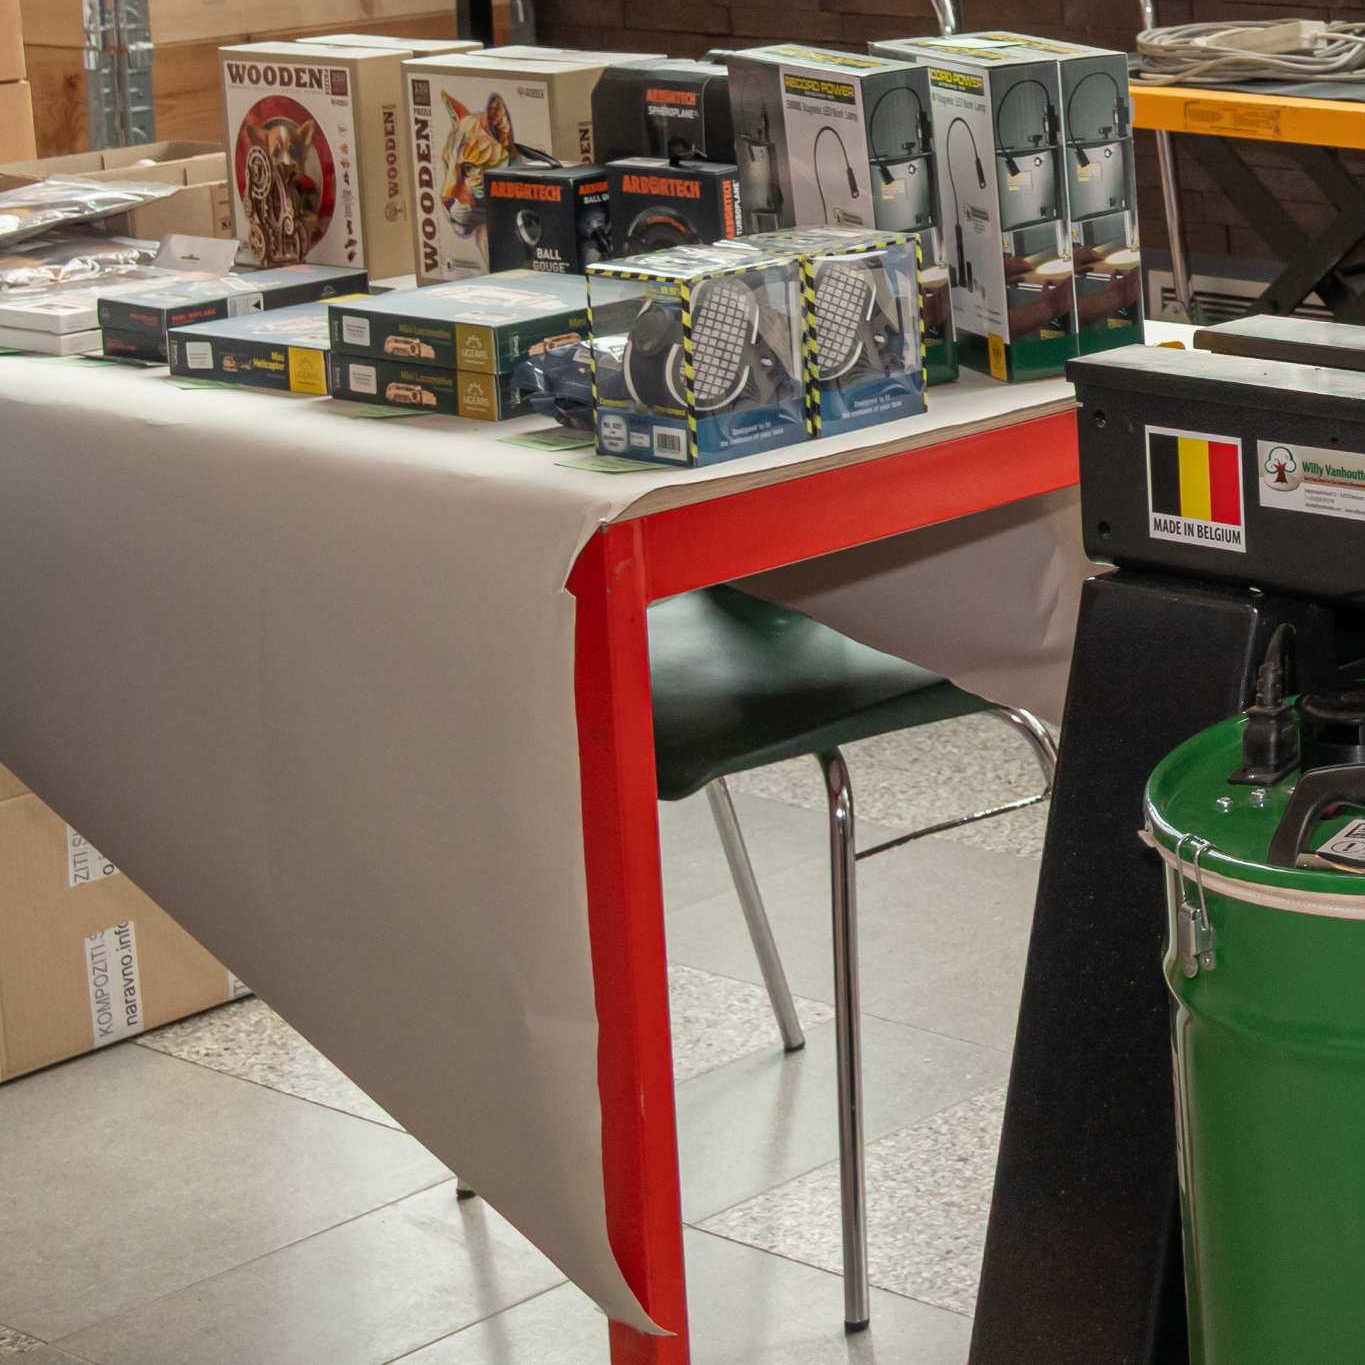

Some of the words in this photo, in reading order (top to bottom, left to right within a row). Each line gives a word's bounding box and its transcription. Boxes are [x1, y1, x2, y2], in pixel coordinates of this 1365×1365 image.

[226, 63, 323, 90] WOODEN
[783, 74, 820, 91] RECORD
[820, 81, 855, 97] POWER
[953, 73, 984, 88] POWER
[383, 111, 400, 199] WOODEN
[414, 118, 440, 273] WOODEN
[490, 180, 562, 202] ARBORTECH
[622, 175, 700, 200] ARBORTECH
[536, 247, 562, 261] BALL
[1302, 461, 1324, 477] Willy
[1153, 517, 1182, 536] MADE
[1183, 522, 1195, 537] IN
[1196, 524, 1241, 545] BELGIUM
